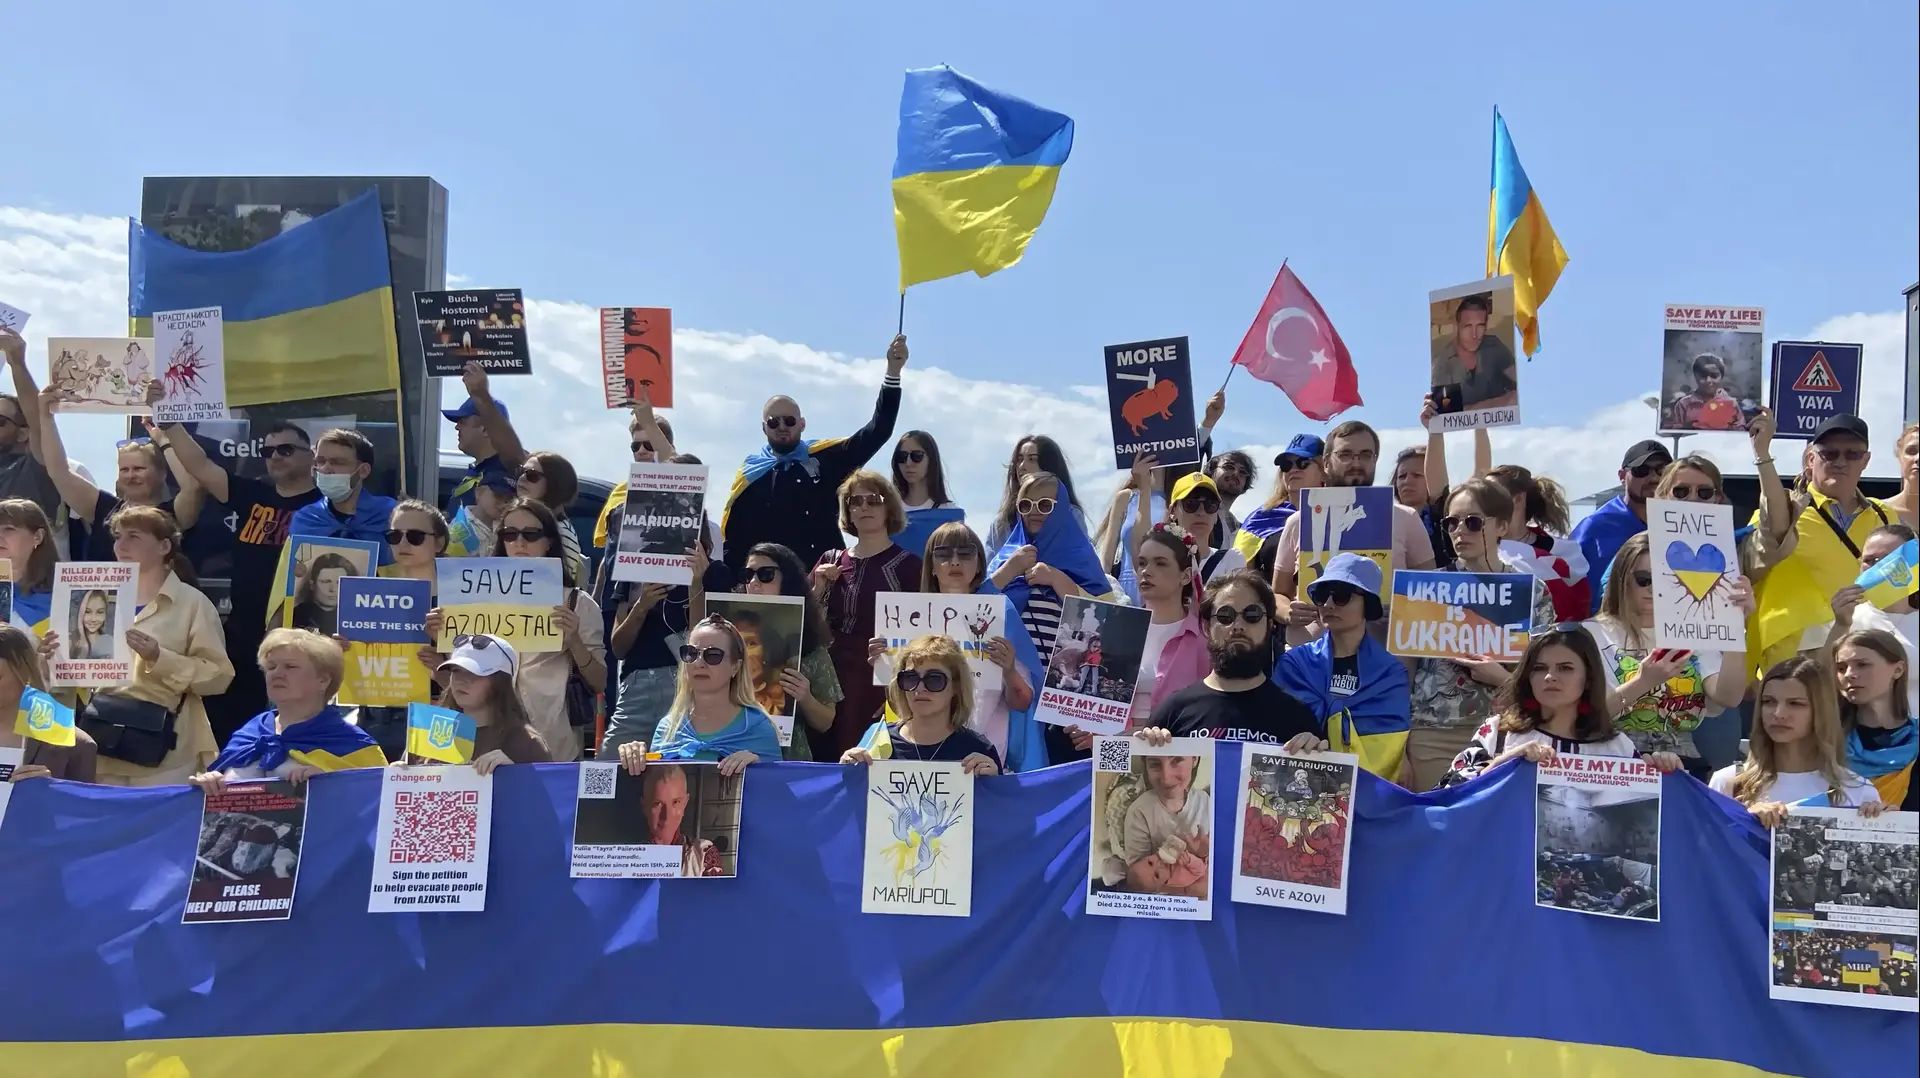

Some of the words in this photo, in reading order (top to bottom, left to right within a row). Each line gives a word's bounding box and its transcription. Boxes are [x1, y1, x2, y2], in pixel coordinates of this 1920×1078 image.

[448, 295, 478, 303] Bucha
[158, 312, 190, 322] КРАСОТА
[191, 310, 219, 319] НИКОГО
[441, 306, 488, 315] Hostomel
[1666, 308, 1701, 318] SAVE
[1704, 309, 1727, 319] MY
[1730, 310, 1762, 320] LIFE!
[168, 322, 177, 330] НЕ
[177, 320, 206, 330] СПАСЛА
[453, 318, 476, 327] Irpin
[1116, 345, 1177, 367] MORE
[476, 359, 523, 368] KRAINE
[607, 374, 628, 406] WAR
[157, 404, 193, 412] КРАСОТА
[194, 402, 223, 411] ТОЛЬКО
[1798, 395, 1834, 410] YAYA
[157, 413, 185, 421] ПОВОД
[187, 412, 204, 420] ДЛЯ
[207, 411, 223, 419] ЗЛА
[1443, 412, 1479, 428] MYKOLA
[1116, 437, 1196, 454] SANCTIONS
[623, 514, 700, 529] MARIUPOL
[1664, 510, 1717, 537] SAVE
[618, 555, 642, 564] SAVE
[644, 557, 665, 566] OUR
[61, 567, 94, 575] KILLED
[60, 575, 101, 583] RUSSIAN
[102, 575, 132, 583] ARMY
[461, 569, 534, 595] SAVE
[1406, 581, 1512, 606] UKRAINE
[355, 594, 414, 610] NATO
[884, 602, 958, 635] Help
[342, 621, 377, 630] CLOSE
[380, 622, 402, 631] THE
[404, 623, 426, 632] SKY
[445, 613, 559, 638] AZOVSTAL
[1664, 622, 1736, 641] MARIUPOL
[1395, 620, 1523, 656] UKRAINE
[55, 663, 85, 671] NEVER
[89, 662, 128, 670] FORGIVE
[357, 655, 410, 679] WE
[56, 672, 86, 680] NEVER
[92, 672, 128, 680] FORGET
[1042, 692, 1074, 706] SAVE
[1075, 699, 1096, 711] MY
[1098, 704, 1128, 718] LIFE!
[1057, 706, 1091, 716] EVACUATION
[1092, 713, 1124, 723] CORRIDORS
[1075, 714, 1103, 723] MARIUPOL
[1262, 755, 1286, 767] SAVE
[1288, 760, 1344, 773] MARIUPOL!
[1539, 757, 1584, 771] SAVE
[1587, 759, 1616, 773] MY
[390, 773, 442, 783] change.org
[889, 771, 950, 794] SAVE
[1564, 772, 1611, 780] EVACUATION
[1612, 775, 1659, 784] CORRIDORS
[1590, 779, 1631, 787] MARIUPOL
[392, 870, 413, 881] Sign
[415, 870, 430, 880] the
[431, 870, 468, 881] petition
[222, 884, 261, 897] PLEASE
[374, 884, 383, 892] to
[384, 883, 406, 893] help
[407, 883, 450, 892] evacuate
[451, 882, 484, 892] people
[394, 895, 416, 904] from
[417, 895, 460, 904] AZOVSTAL
[1256, 885, 1285, 899] SAVE
[1288, 891, 1326, 905] AZOV!
[186, 901, 213, 914] HELP
[214, 900, 236, 913] OUR
[237, 898, 290, 911] CHILDREN
[1114, 902, 1149, 910] 23.04.2022
